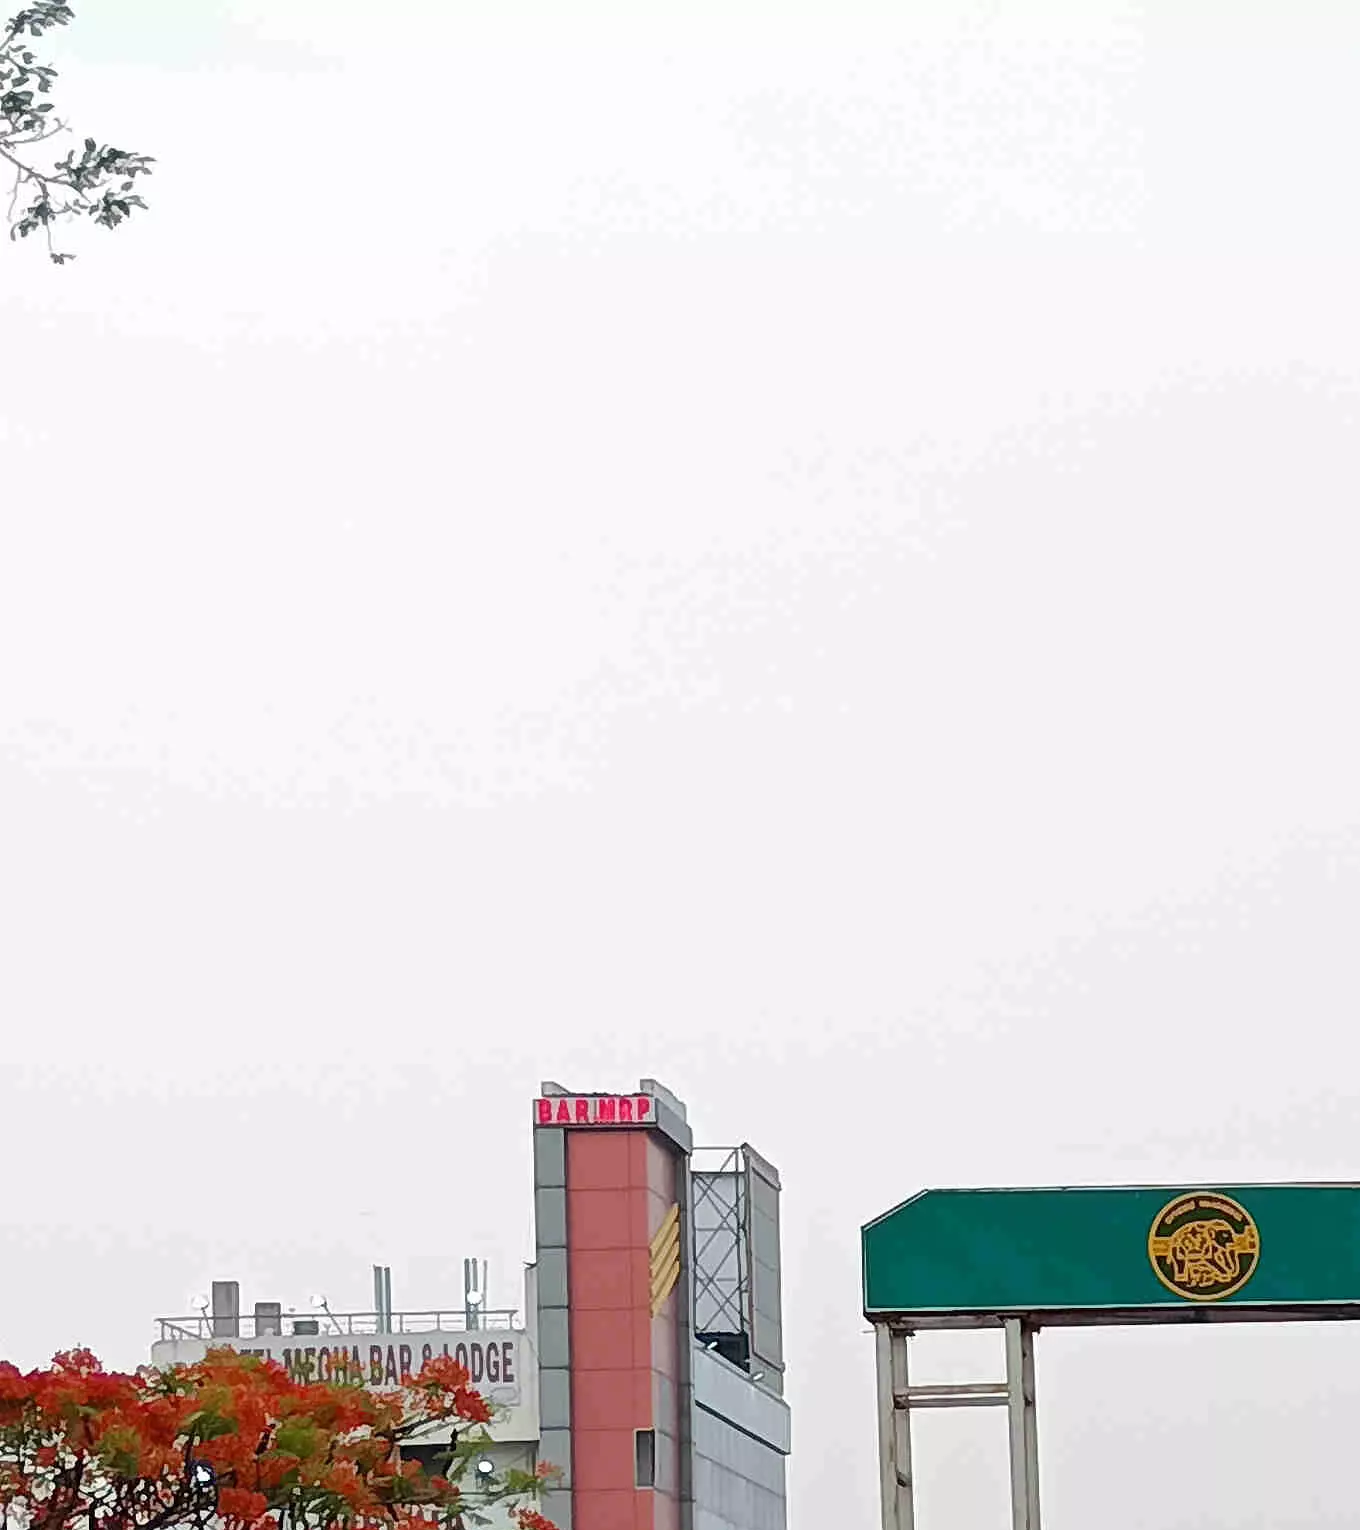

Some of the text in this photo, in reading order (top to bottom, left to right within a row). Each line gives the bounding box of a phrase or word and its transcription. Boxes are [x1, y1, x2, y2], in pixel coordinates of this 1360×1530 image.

[538, 1098, 588, 1122] BAR
[370, 1344, 411, 1385] BAR
[443, 1342, 515, 1383] ODGE
